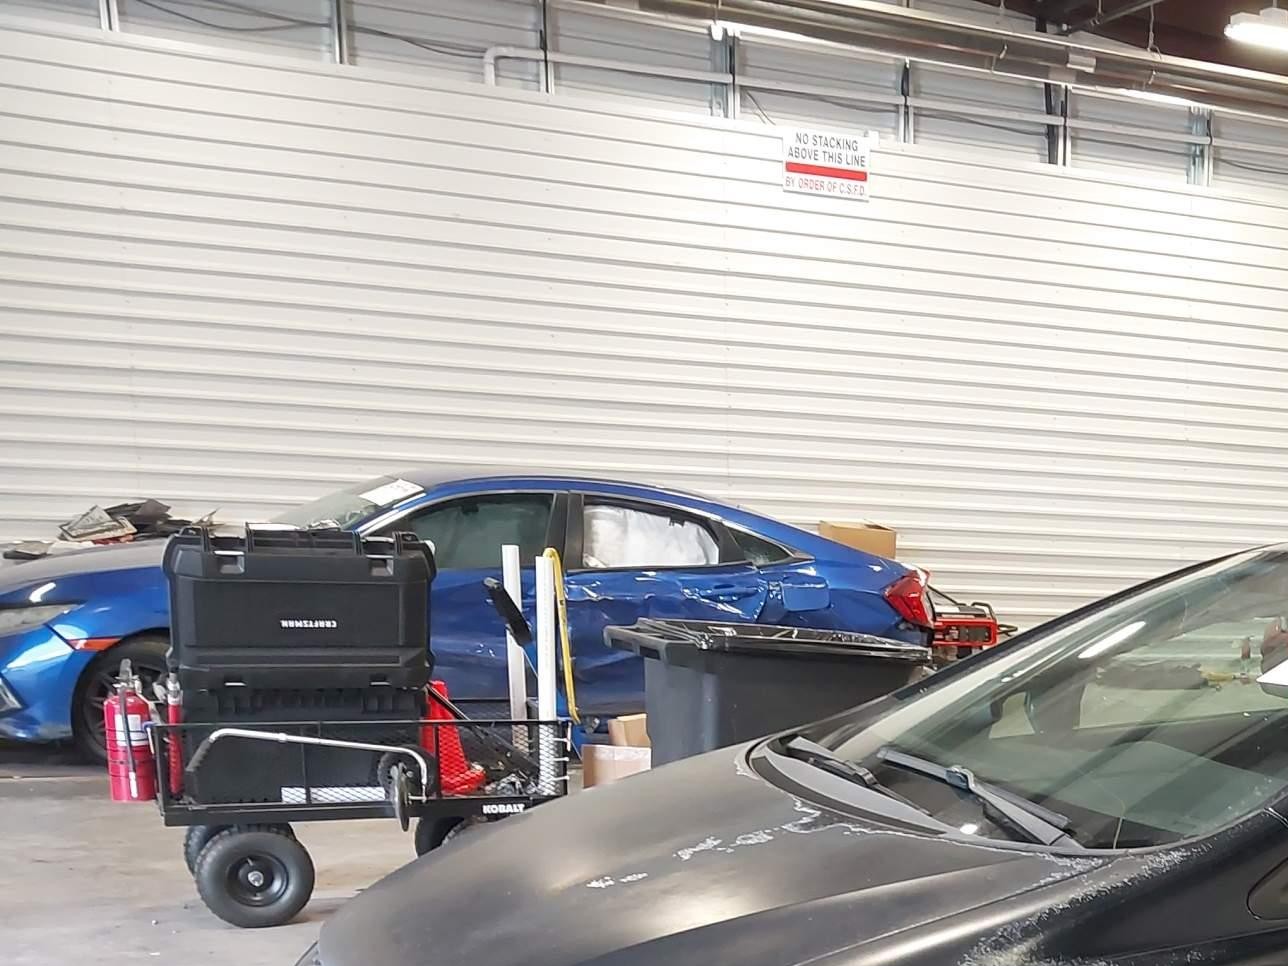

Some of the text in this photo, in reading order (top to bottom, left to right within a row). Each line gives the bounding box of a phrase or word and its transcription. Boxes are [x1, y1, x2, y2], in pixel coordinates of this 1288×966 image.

[796, 132, 858, 152] NO STACKING
[788, 146, 866, 168] ABOVE THIS LINE
[786, 176, 795, 188] BY
[798, 177, 825, 191] ORDER
[827, 180, 837, 192] OF
[280, 619, 337, 628] CRAFTSMAN
[482, 803, 526, 814] KOBALT
